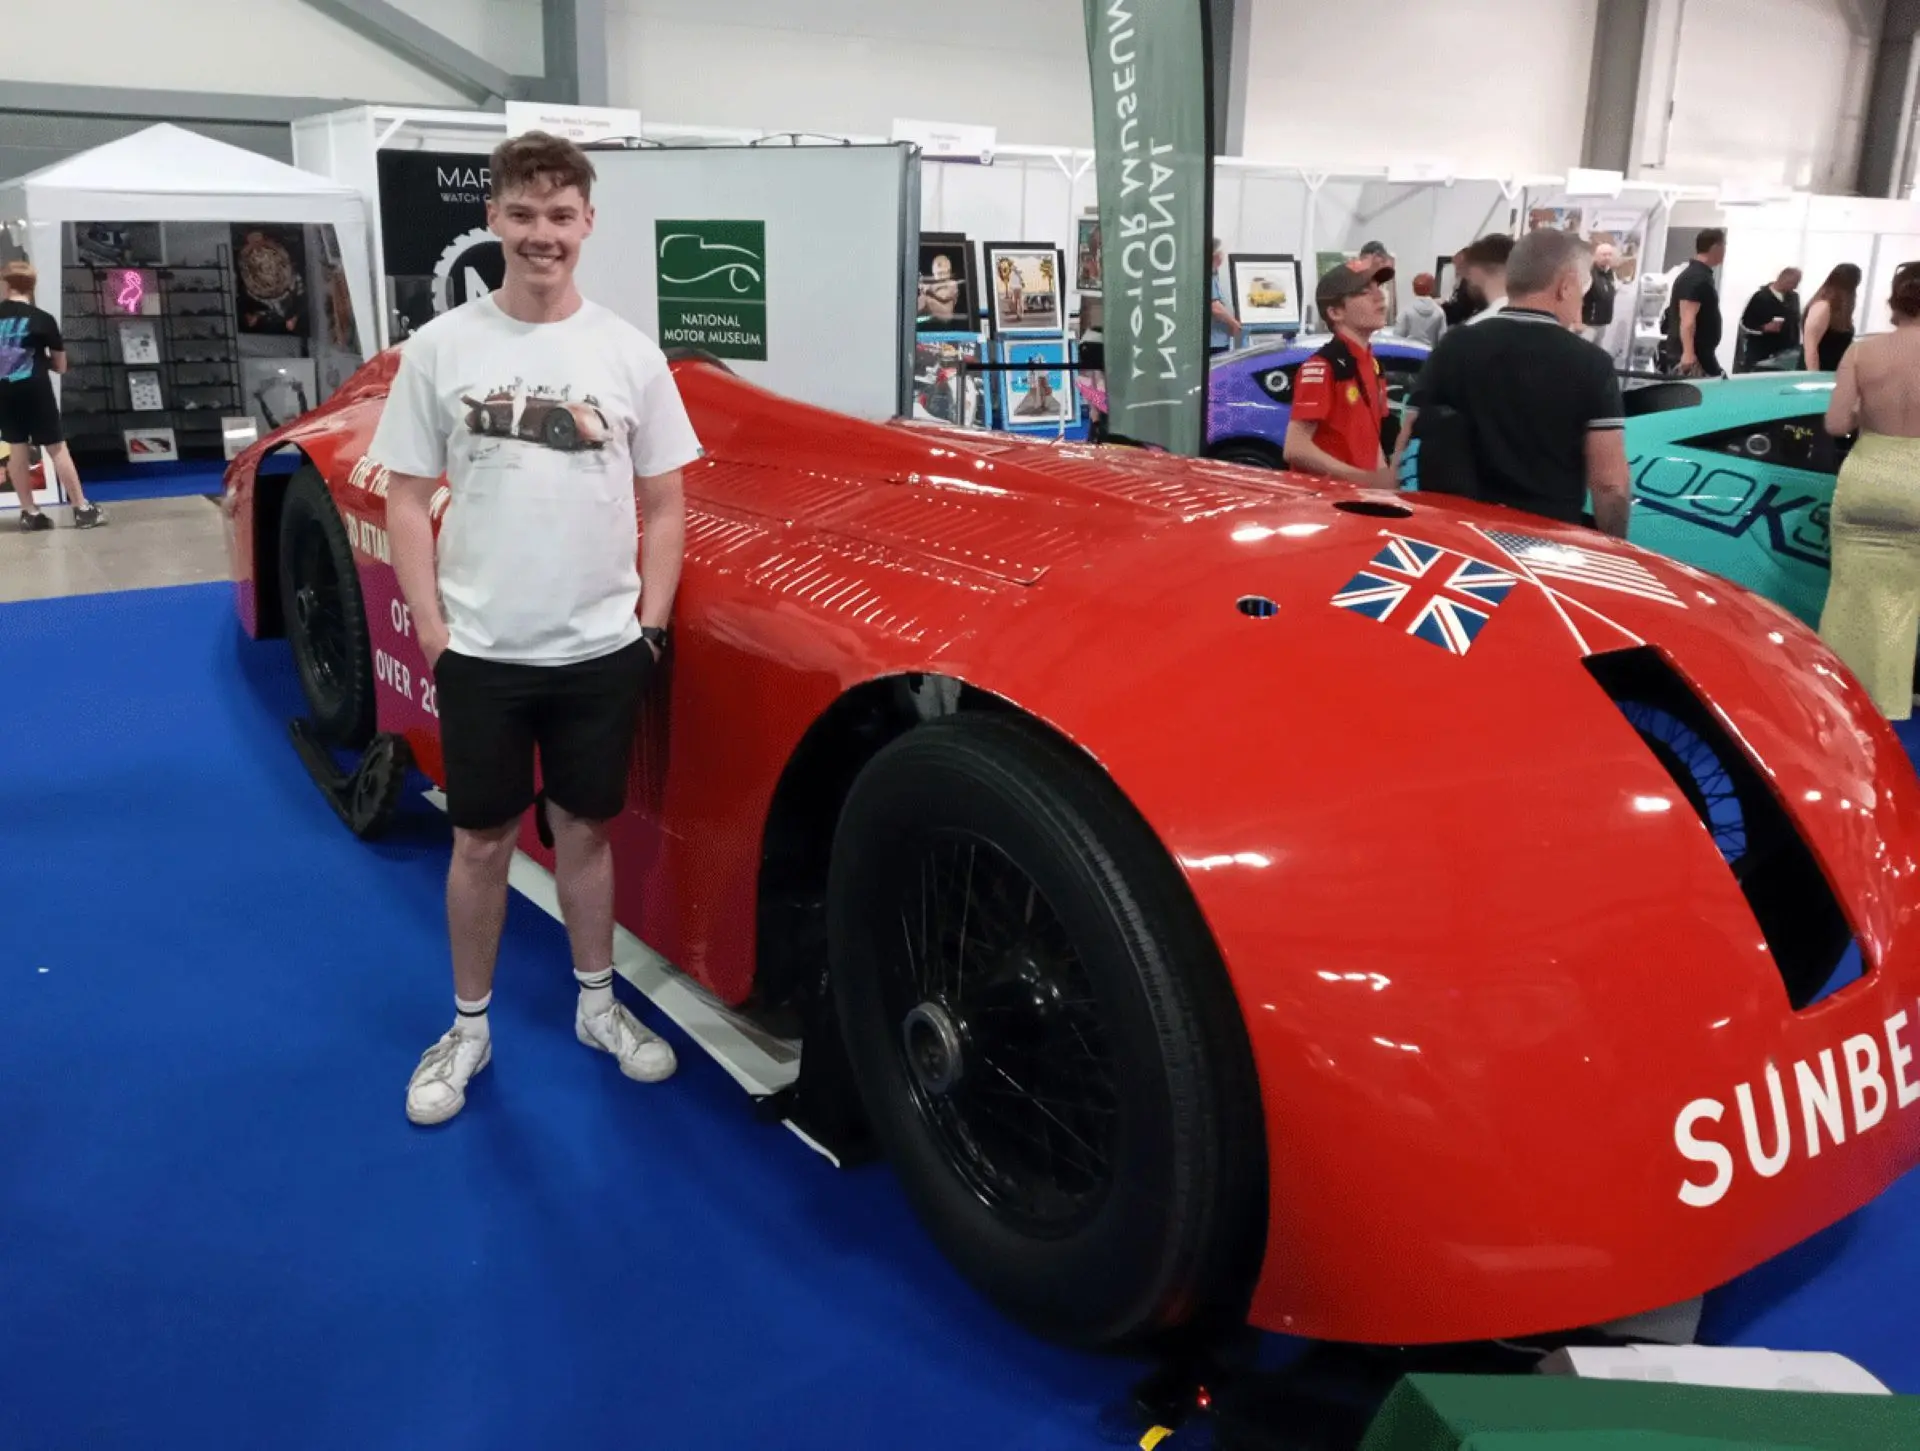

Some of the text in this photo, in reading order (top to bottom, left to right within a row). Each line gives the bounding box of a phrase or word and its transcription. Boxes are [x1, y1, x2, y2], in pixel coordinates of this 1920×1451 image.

[441, 193, 480, 203] WATCH
[680, 312, 741, 327] NATIONAL
[664, 328, 761, 345] MOTOR MUSEUM
[391, 598, 411, 637] OF
[376, 648, 412, 700] OVER
[1674, 1009, 1920, 1208] SUNBE
